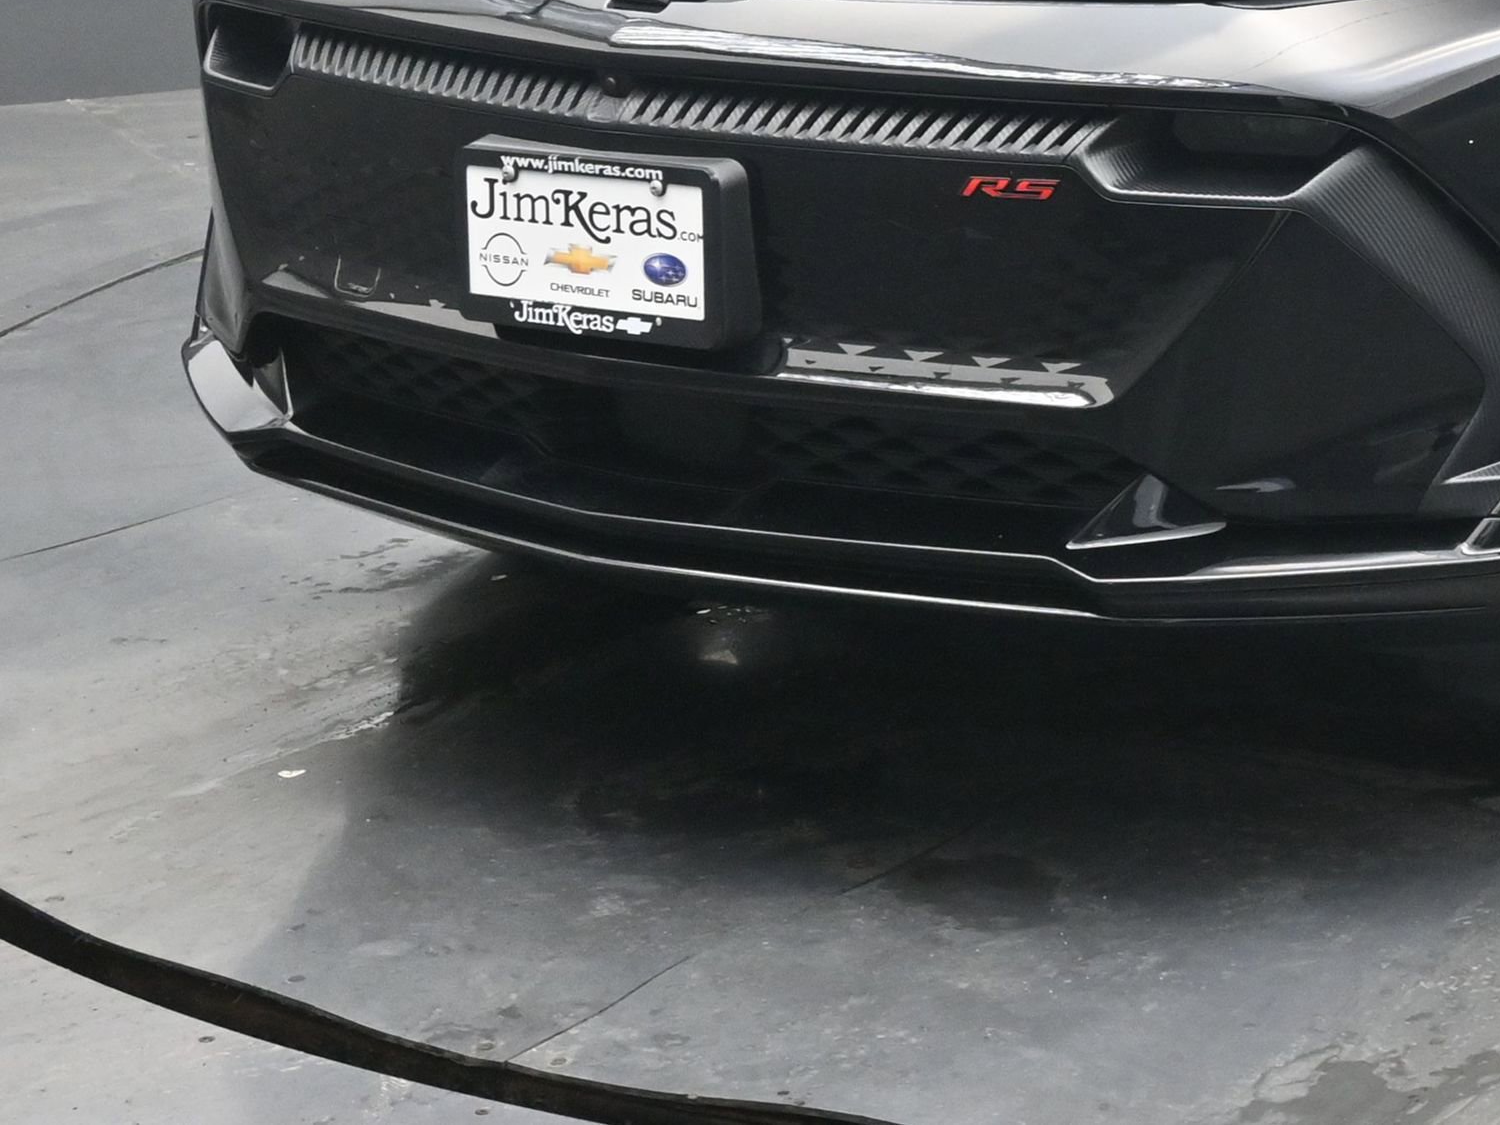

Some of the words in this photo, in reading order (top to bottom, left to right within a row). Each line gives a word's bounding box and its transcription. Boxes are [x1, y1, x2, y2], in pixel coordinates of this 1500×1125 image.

[500, 155, 662, 180] www.jimkeras.com
[962, 176, 1060, 200] RS
[479, 253, 528, 266] NISSAN
[550, 282, 610, 298] CHEVROLET
[631, 288, 698, 308] SUBARU
